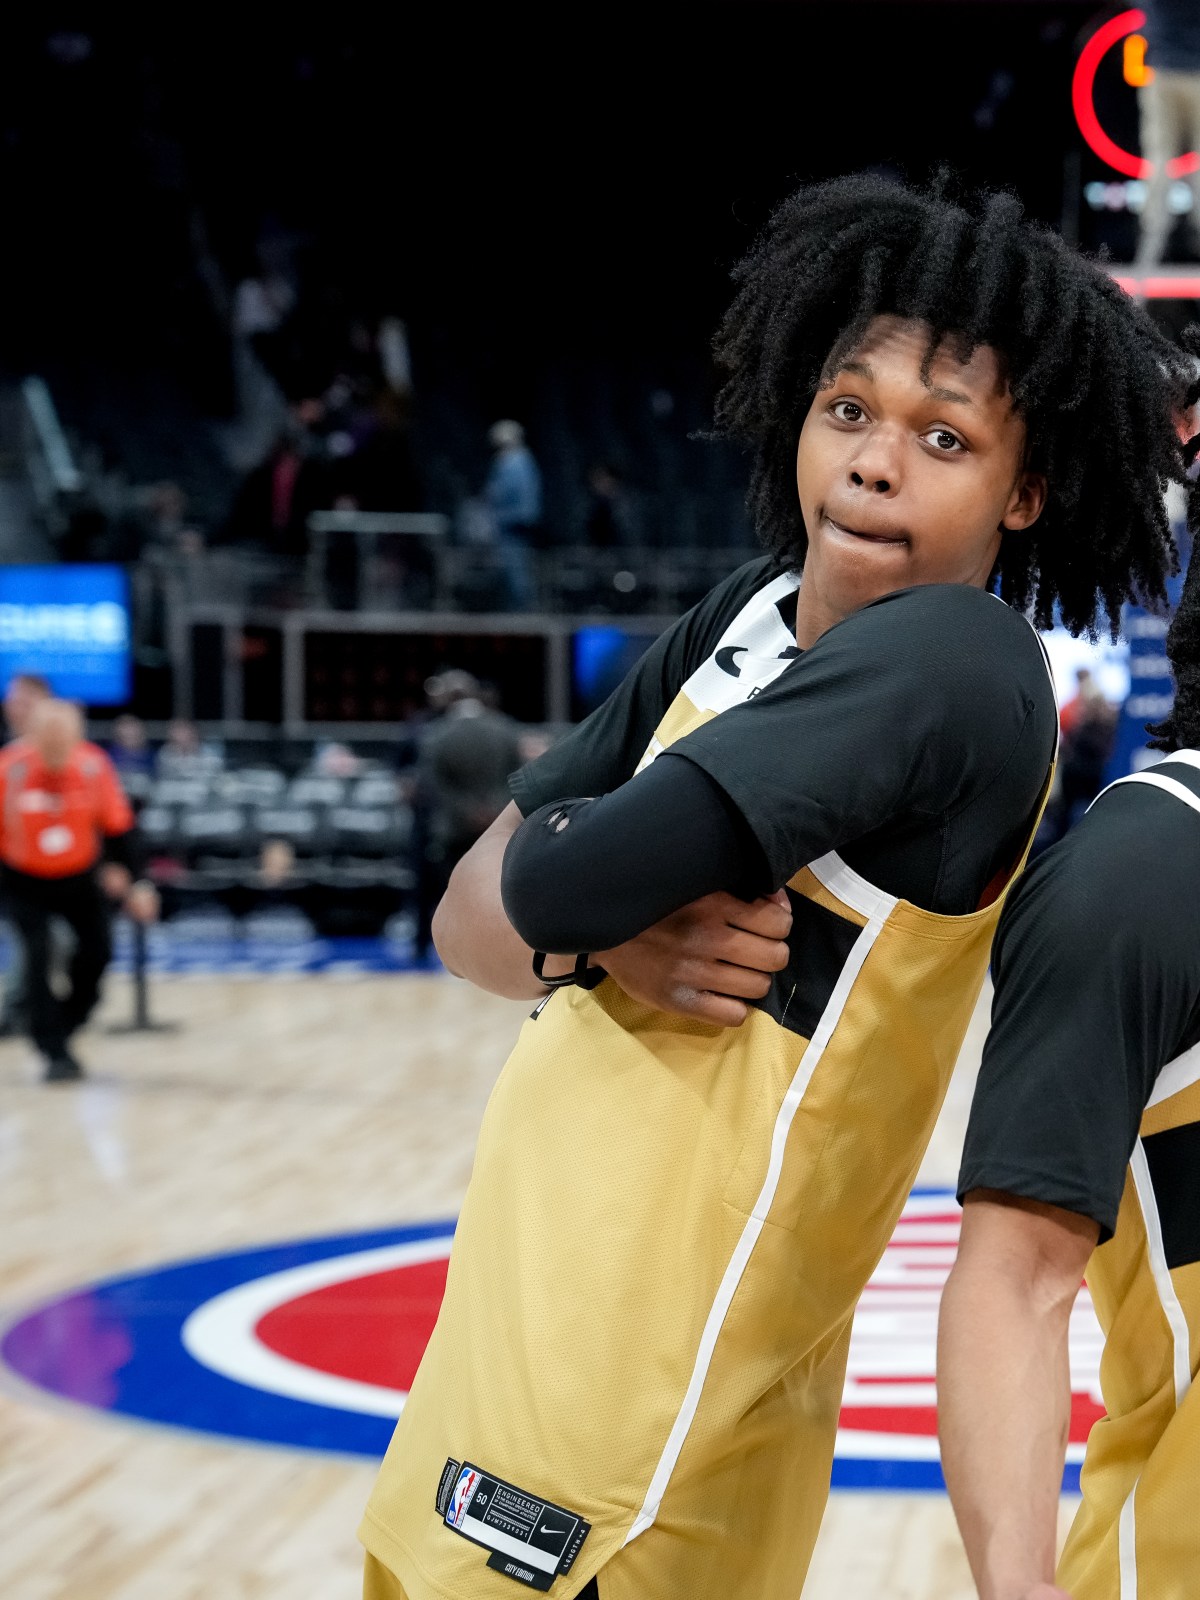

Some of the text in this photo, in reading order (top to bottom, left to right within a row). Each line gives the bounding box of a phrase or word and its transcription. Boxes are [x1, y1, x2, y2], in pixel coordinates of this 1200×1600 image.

[476, 1492, 488, 1506] 50
[497, 1488, 541, 1513] ENGINEERED
[563, 1539, 581, 1568] LENGTH
[504, 1563, 535, 1582] CITY EDITION
